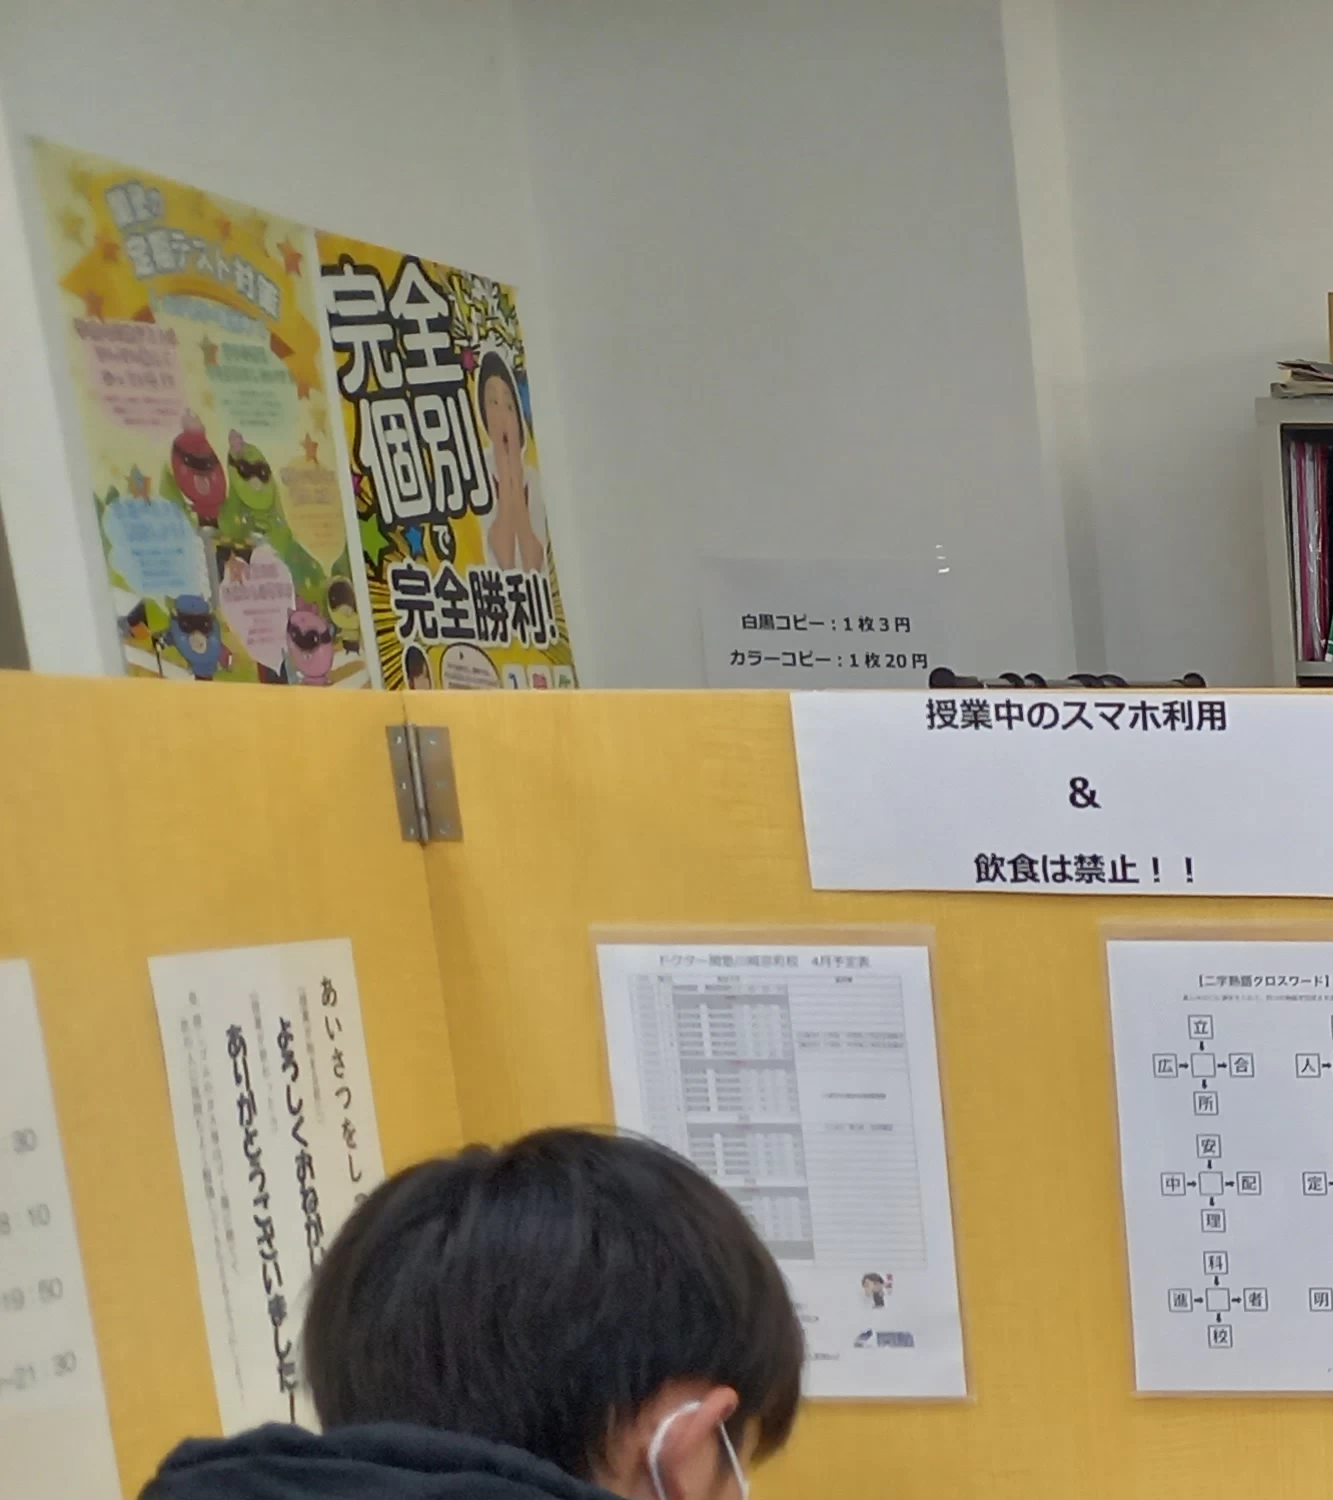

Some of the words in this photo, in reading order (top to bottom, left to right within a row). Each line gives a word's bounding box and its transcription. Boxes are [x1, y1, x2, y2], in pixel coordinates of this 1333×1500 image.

[321, 260, 464, 396] 完全
[358, 391, 494, 523] 個別
[432, 526, 457, 560] で
[926, 699, 1228, 732] 授業中のスマホ利用
[1068, 776, 1100, 809] &
[1194, 1020, 1208, 1034] 立
[1158, 1059, 1173, 1073] 広
[1234, 1057, 1248, 1073] 合
[1301, 1058, 1315, 1073] 人
[1199, 1096, 1213, 1111] 所
[1201, 1138, 1216, 1154] 安
[1166, 1176, 1180, 1192] 中
[1242, 1176, 1256, 1190] 配
[1308, 1176, 1322, 1191] 定
[1314, 1292, 1329, 1307] 明
[1214, 1329, 1227, 1343] 校
